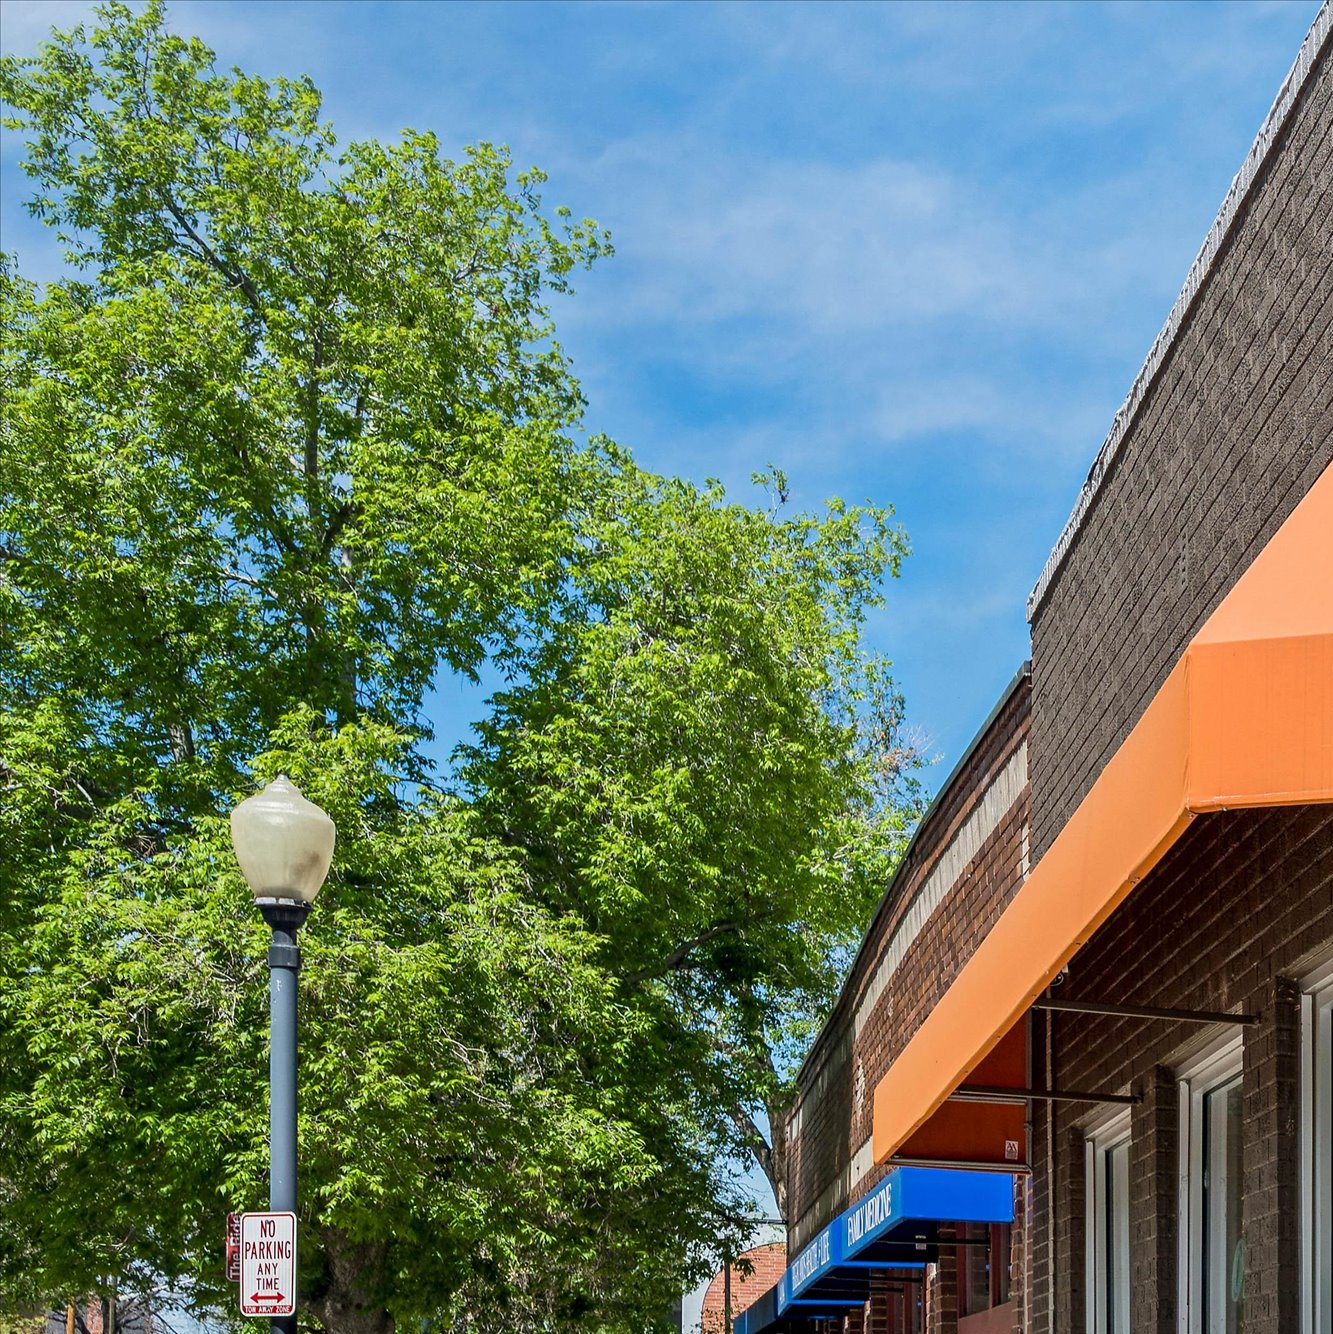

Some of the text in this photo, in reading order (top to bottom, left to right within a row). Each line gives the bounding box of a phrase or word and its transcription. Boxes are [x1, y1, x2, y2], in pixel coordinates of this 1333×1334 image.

[260, 1220, 276, 1238] NO
[245, 1241, 291, 1260] PARKING
[257, 1263, 278, 1275] ANY
[256, 1278, 279, 1290] TIME
